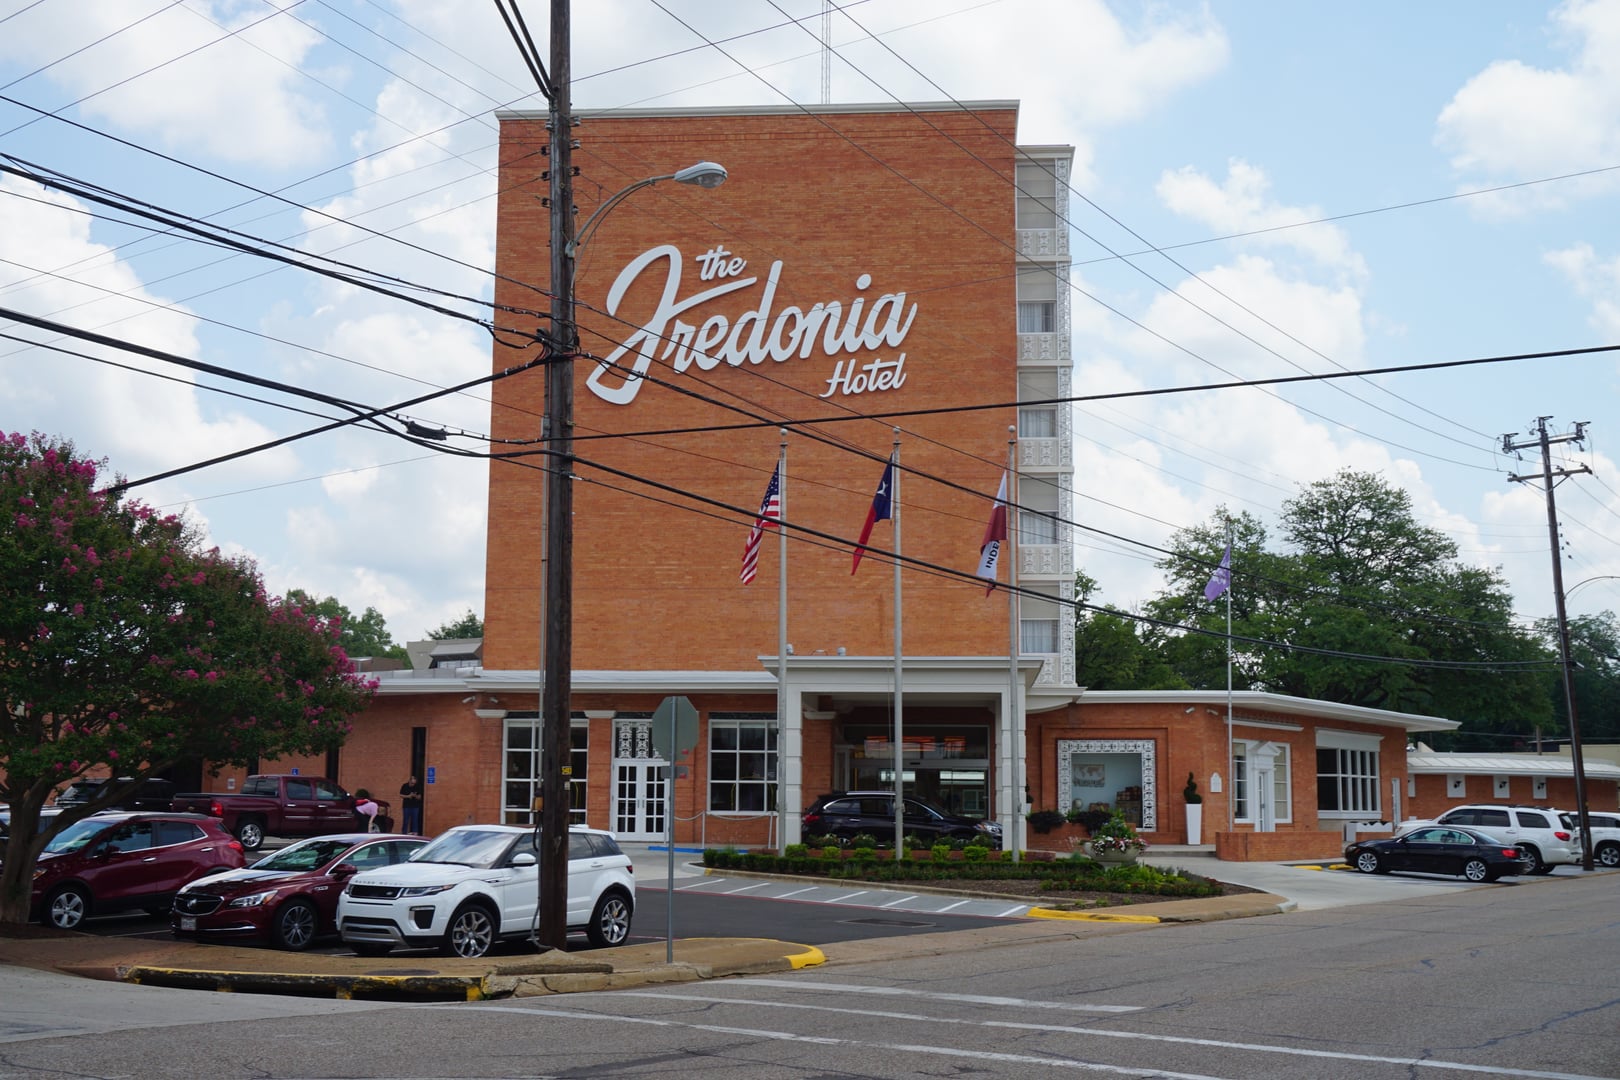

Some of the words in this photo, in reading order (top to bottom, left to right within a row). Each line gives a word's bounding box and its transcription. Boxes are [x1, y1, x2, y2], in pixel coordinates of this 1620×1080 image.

[696, 244, 748, 281] the
[585, 244, 918, 405] Fredonia
[818, 352, 907, 398] Hotel
